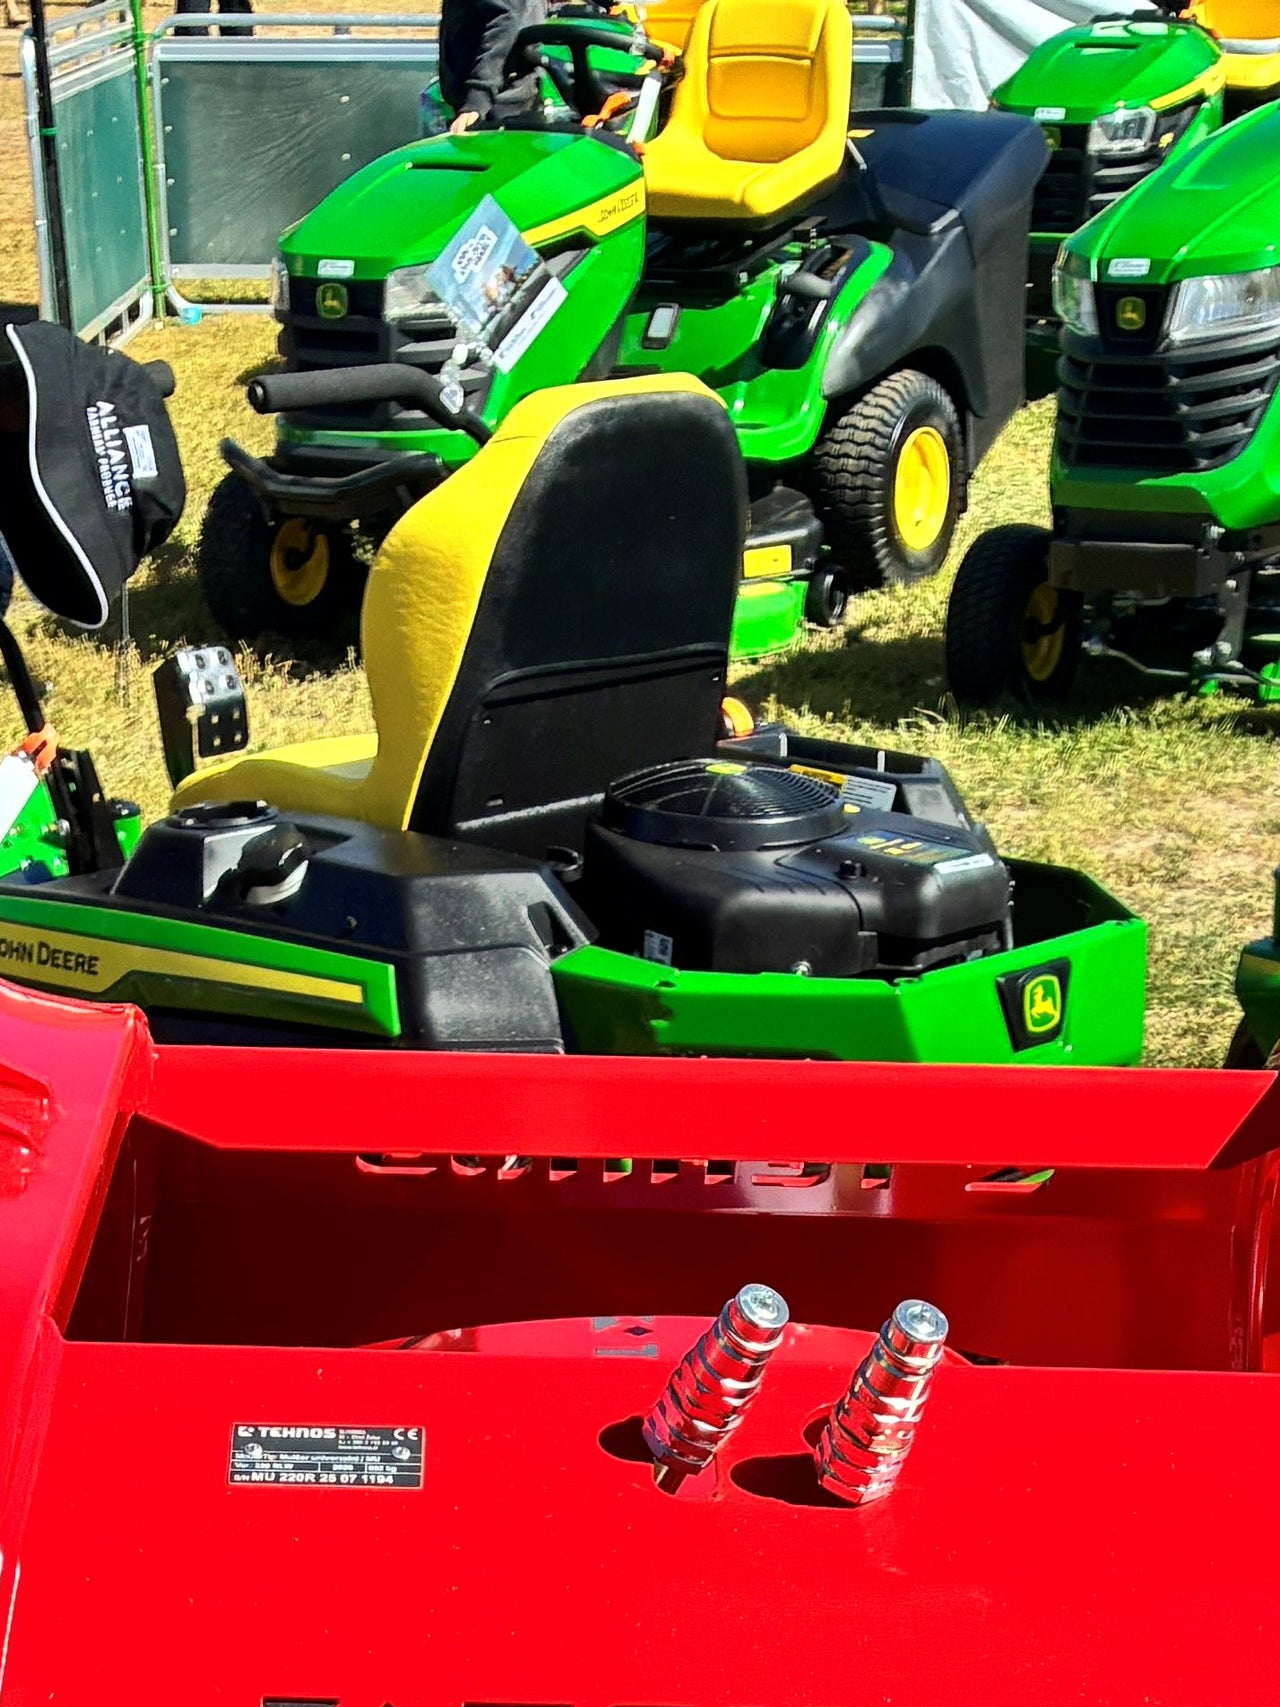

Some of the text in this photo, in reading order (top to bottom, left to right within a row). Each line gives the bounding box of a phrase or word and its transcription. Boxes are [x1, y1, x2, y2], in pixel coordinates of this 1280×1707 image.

[96, 400, 133, 511] ALLIANCE
[37, 941, 99, 976] DEERE
[258, 1426, 337, 1439] TEHNOS
[251, 1472, 276, 1482] MU
[279, 1473, 316, 1483] 220R
[340, 1474, 358, 1484] 07
